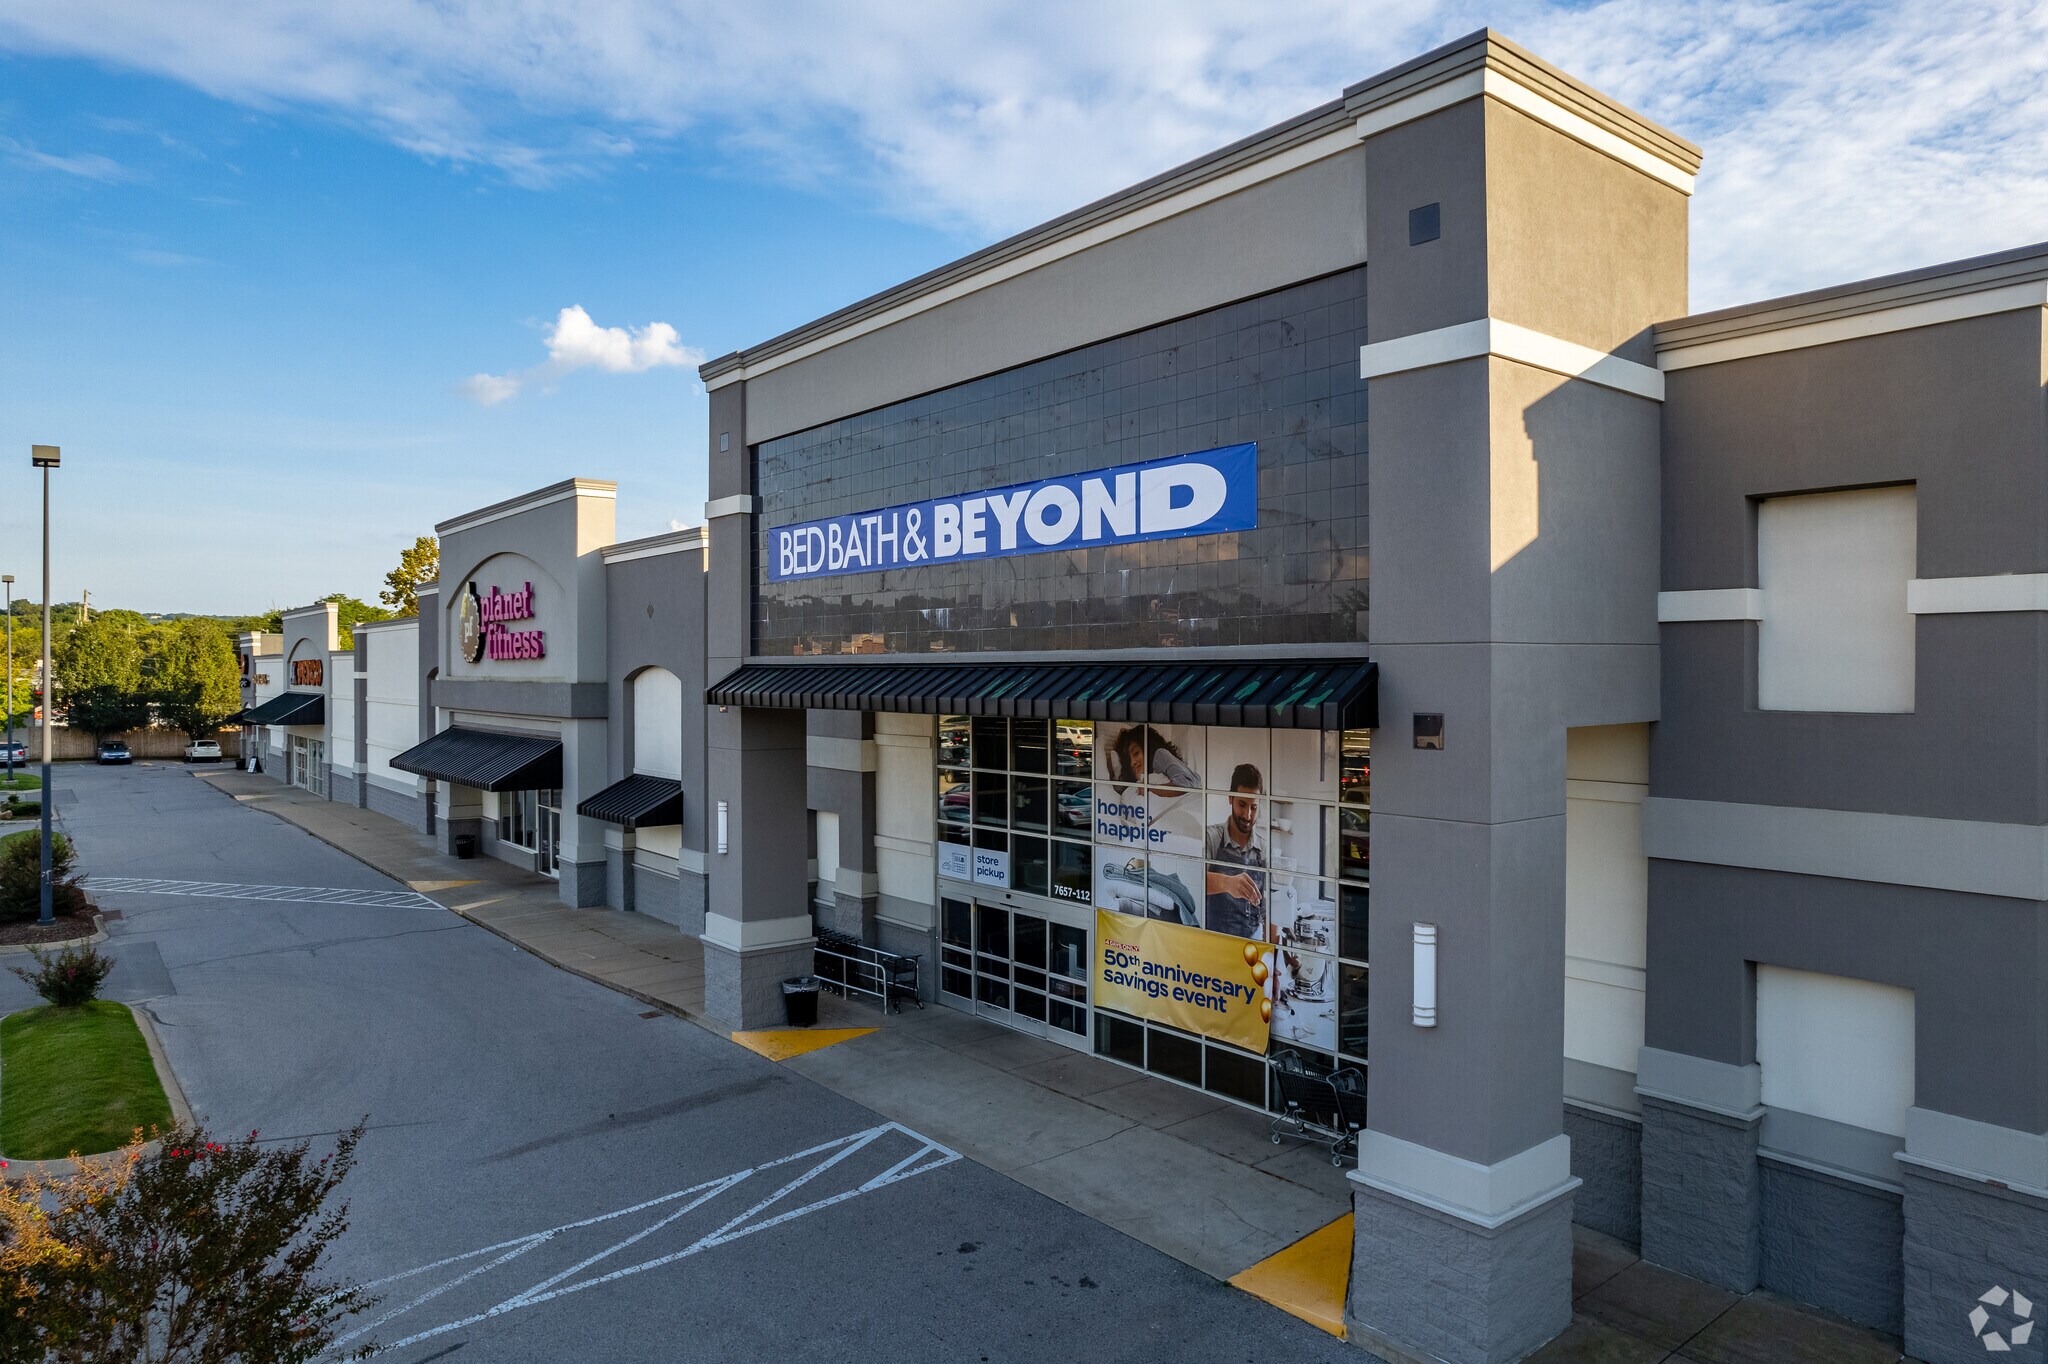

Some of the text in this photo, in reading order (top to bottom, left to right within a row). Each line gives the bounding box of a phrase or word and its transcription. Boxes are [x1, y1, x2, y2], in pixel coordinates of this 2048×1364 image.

[780, 463, 1227, 576] BED BATH & BEYOND
[480, 581, 533, 633] planet
[486, 624, 543, 660] fitness
[1097, 798, 1153, 823] home,
[976, 854, 999, 866] store
[976, 865, 1005, 880] pickup
[1053, 884, 1091, 901] 7657-112
[1103, 969, 1227, 1013] savings event
[1104, 949, 1256, 1004] 50th anniversary
